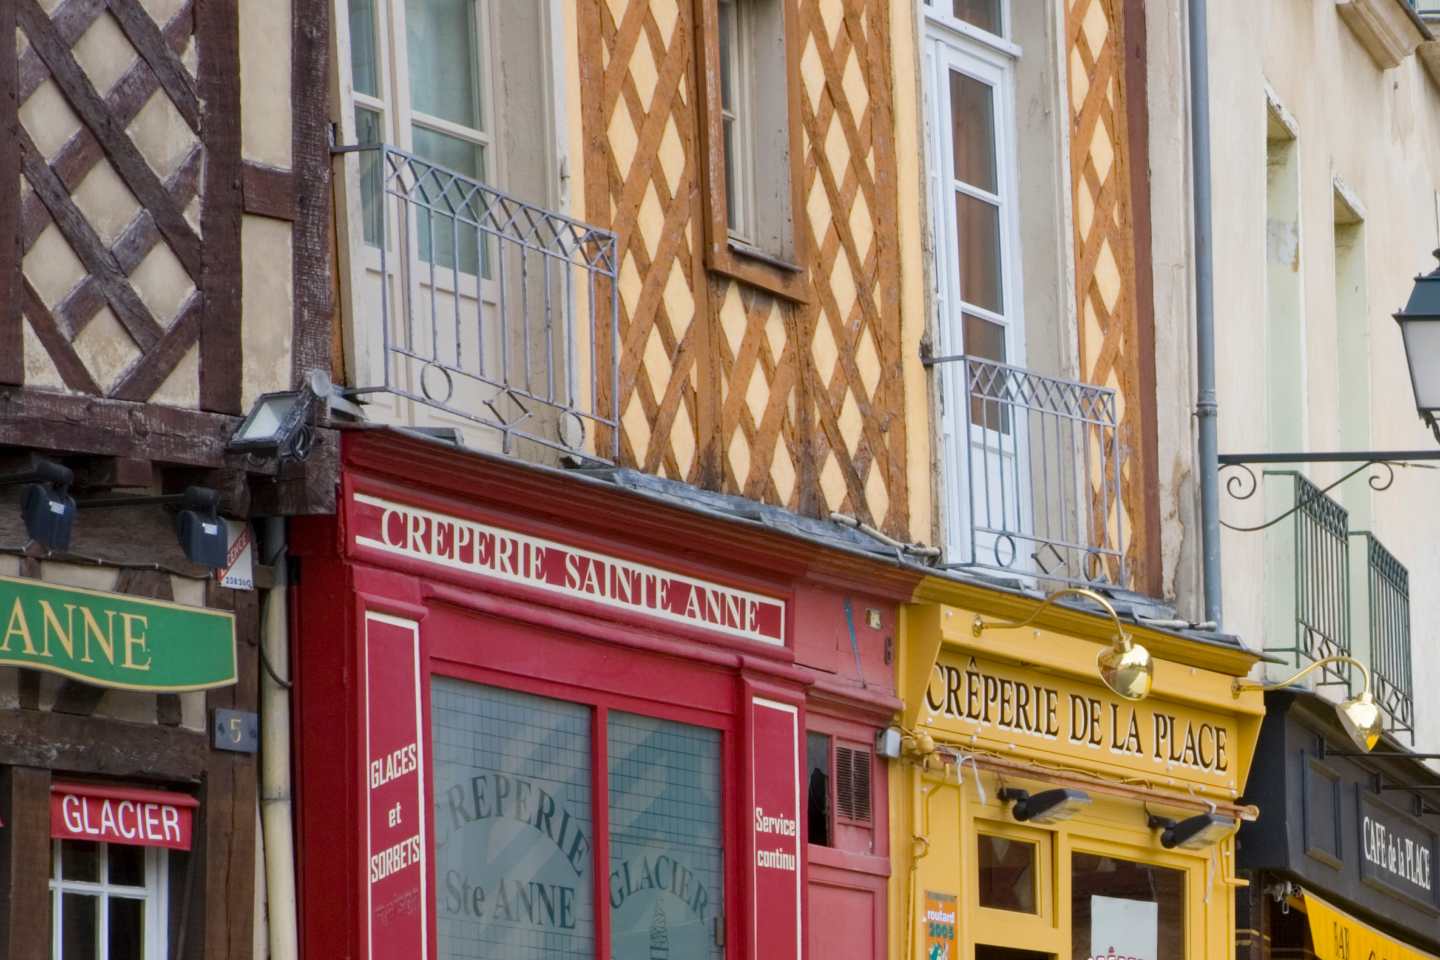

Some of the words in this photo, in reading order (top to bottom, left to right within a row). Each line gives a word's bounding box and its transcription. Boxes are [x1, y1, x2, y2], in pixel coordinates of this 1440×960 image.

[381, 508, 546, 582] CREPERIE
[564, 551, 672, 612] SAINTE
[682, 587, 760, 635] ANNE
[0, 597, 152, 670] ANNE
[228, 719, 239, 744] 5
[925, 656, 1060, 738] CRÊPERIE
[1069, 693, 1103, 747] DE
[1110, 702, 1143, 755] LA
[1152, 712, 1229, 774] PLACE
[370, 743, 417, 790] GLACES
[62, 794, 181, 843] GLACIER
[388, 801, 403, 828] et
[433, 774, 591, 877] REPERIE
[755, 807, 796, 836] Service
[370, 834, 421, 883] SORBETS
[757, 847, 796, 871] continu
[1363, 816, 1387, 868] CAFE
[1387, 833, 1397, 874] de
[1397, 837, 1405, 877] la
[1405, 838, 1431, 890] PLACE
[446, 869, 486, 918] Ste
[492, 876, 577, 930] ANNE
[608, 854, 708, 926] GLACIER
